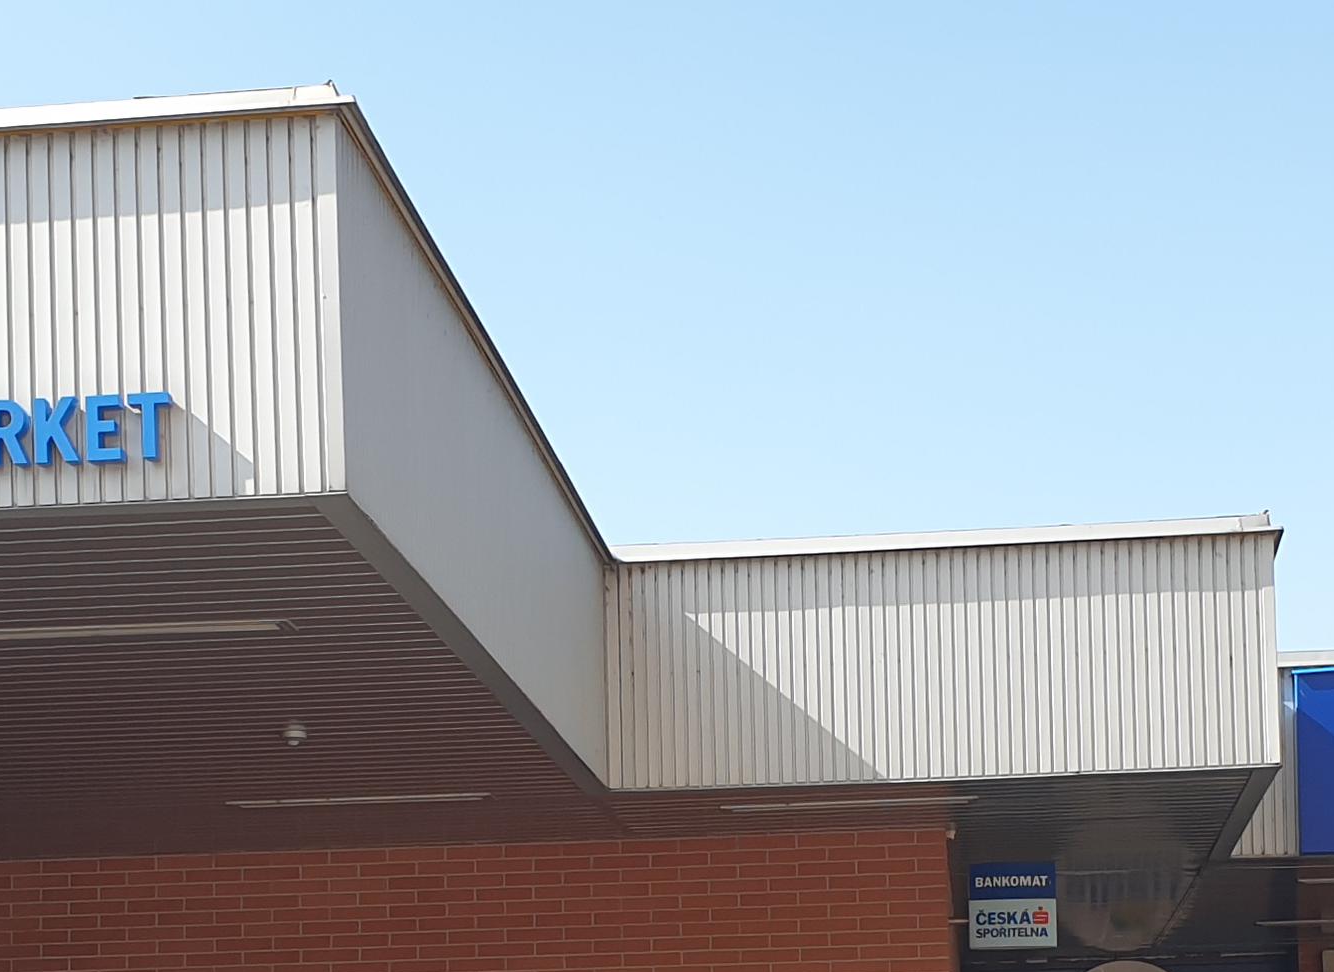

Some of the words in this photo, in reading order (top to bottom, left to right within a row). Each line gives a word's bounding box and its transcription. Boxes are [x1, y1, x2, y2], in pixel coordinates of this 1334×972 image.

[975, 875, 1048, 888] BANKOMAT
[975, 908, 1031, 926] ČESKÁ
[975, 925, 1048, 939] SPOŘITELNA
